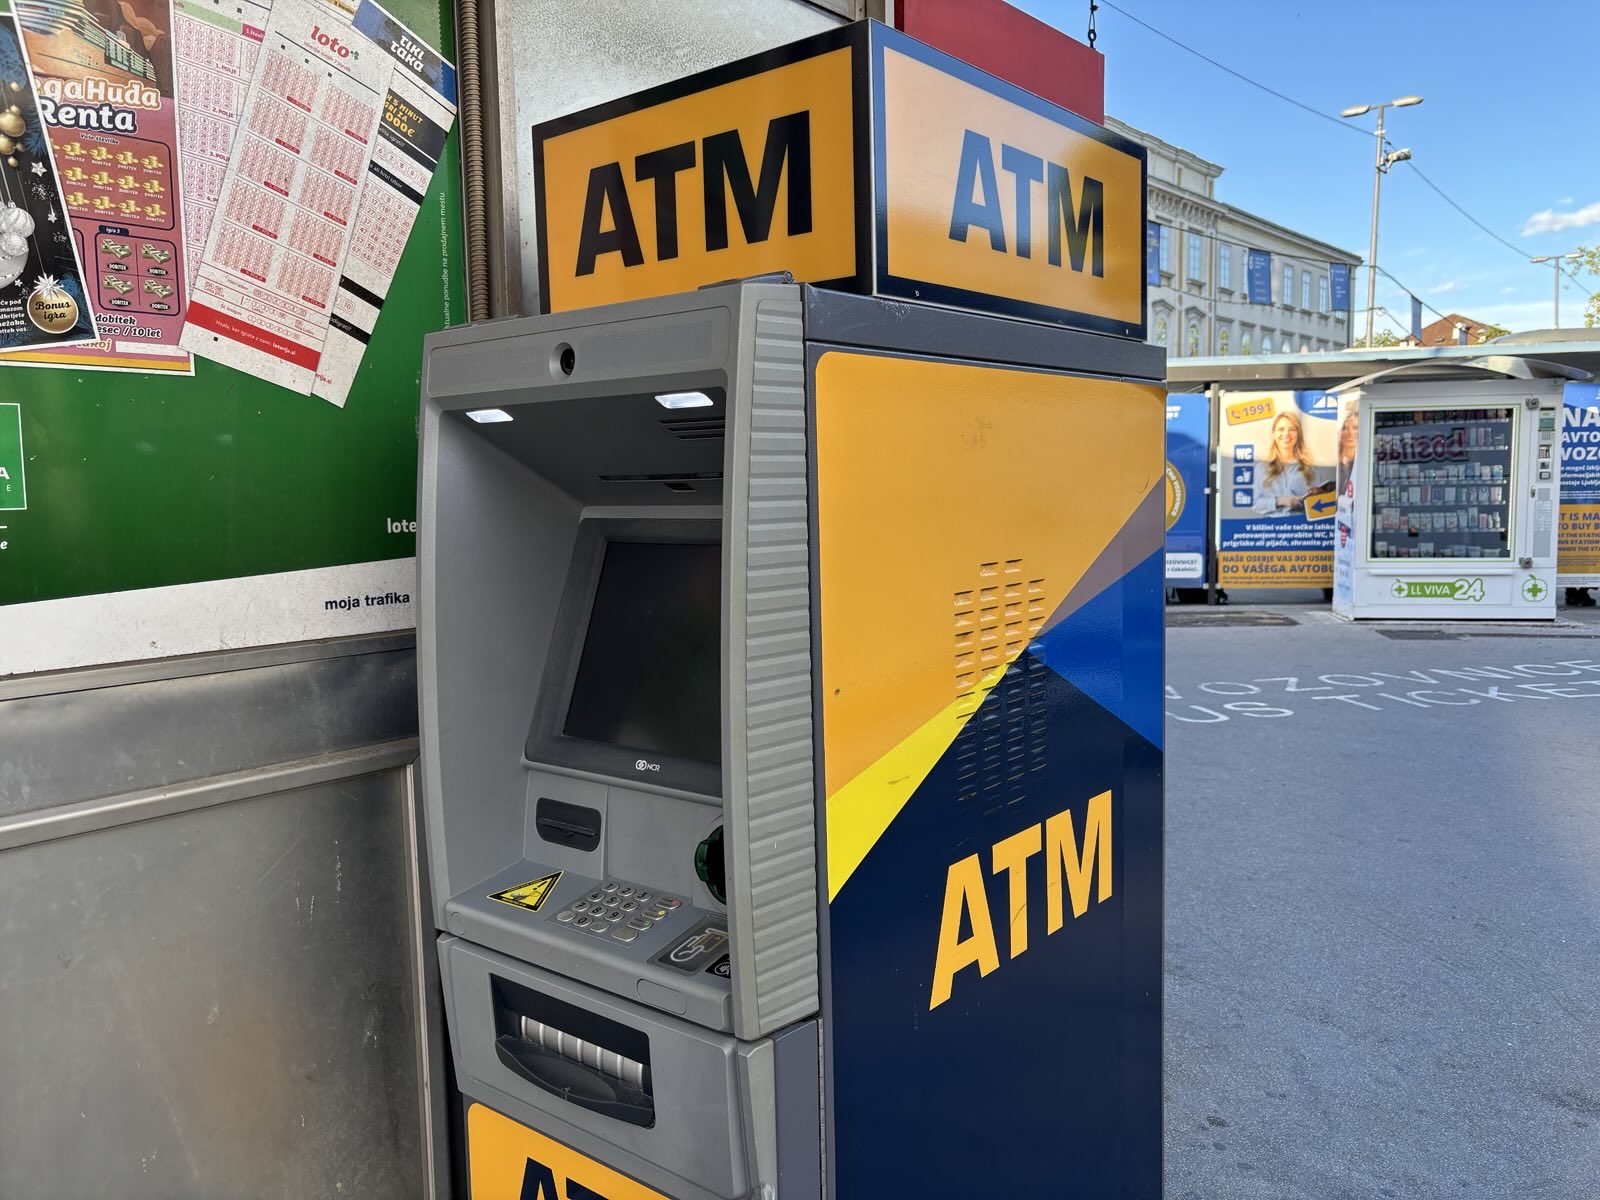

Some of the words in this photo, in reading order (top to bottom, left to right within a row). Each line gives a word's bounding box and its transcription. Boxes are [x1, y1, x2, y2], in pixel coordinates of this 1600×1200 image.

[310, 25, 350, 58] loto
[34, 76, 160, 110] gaHuda
[40, 97, 137, 133] Renta
[218, 108, 234, 118] POLJE
[393, 99, 399, 107] 5
[399, 103, 424, 124] MINUT
[397, 111, 408, 122] ZA
[384, 112, 416, 137] 000€
[575, 110, 812, 277] ATM
[948, 128, 1104, 278] ATM
[443, 258, 448, 267] na
[442, 269, 450, 300] ponudbe
[35, 300, 72, 311] Bonus
[344, 302, 351, 310] 10
[43, 312, 66, 322] igra
[96, 314, 136, 325] dobitek
[129, 328, 146, 336] 10
[147, 328, 161, 338] let
[216, 320, 231, 330] Hvala,
[241, 330, 255, 340] igrate
[272, 342, 296, 356] loterija.si
[1242, 402, 1272, 416] 1991
[1562, 406, 1600, 428] NA
[1562, 432, 1600, 443] AVTO
[1236, 447, 1253, 460] WC
[387, 517, 416, 534] lote
[1222, 565, 1239, 574] DO
[1242, 563, 1286, 573] VAŠEGA
[1411, 585, 1422, 594] LL
[1424, 585, 1450, 594] VIVA
[1454, 578, 1485, 601] 24
[325, 596, 360, 610] moja
[364, 592, 410, 606] trafika
[1165, 702, 1294, 723] US
[646, 763, 661, 772] NCR
[929, 789, 1112, 1011] ATM
